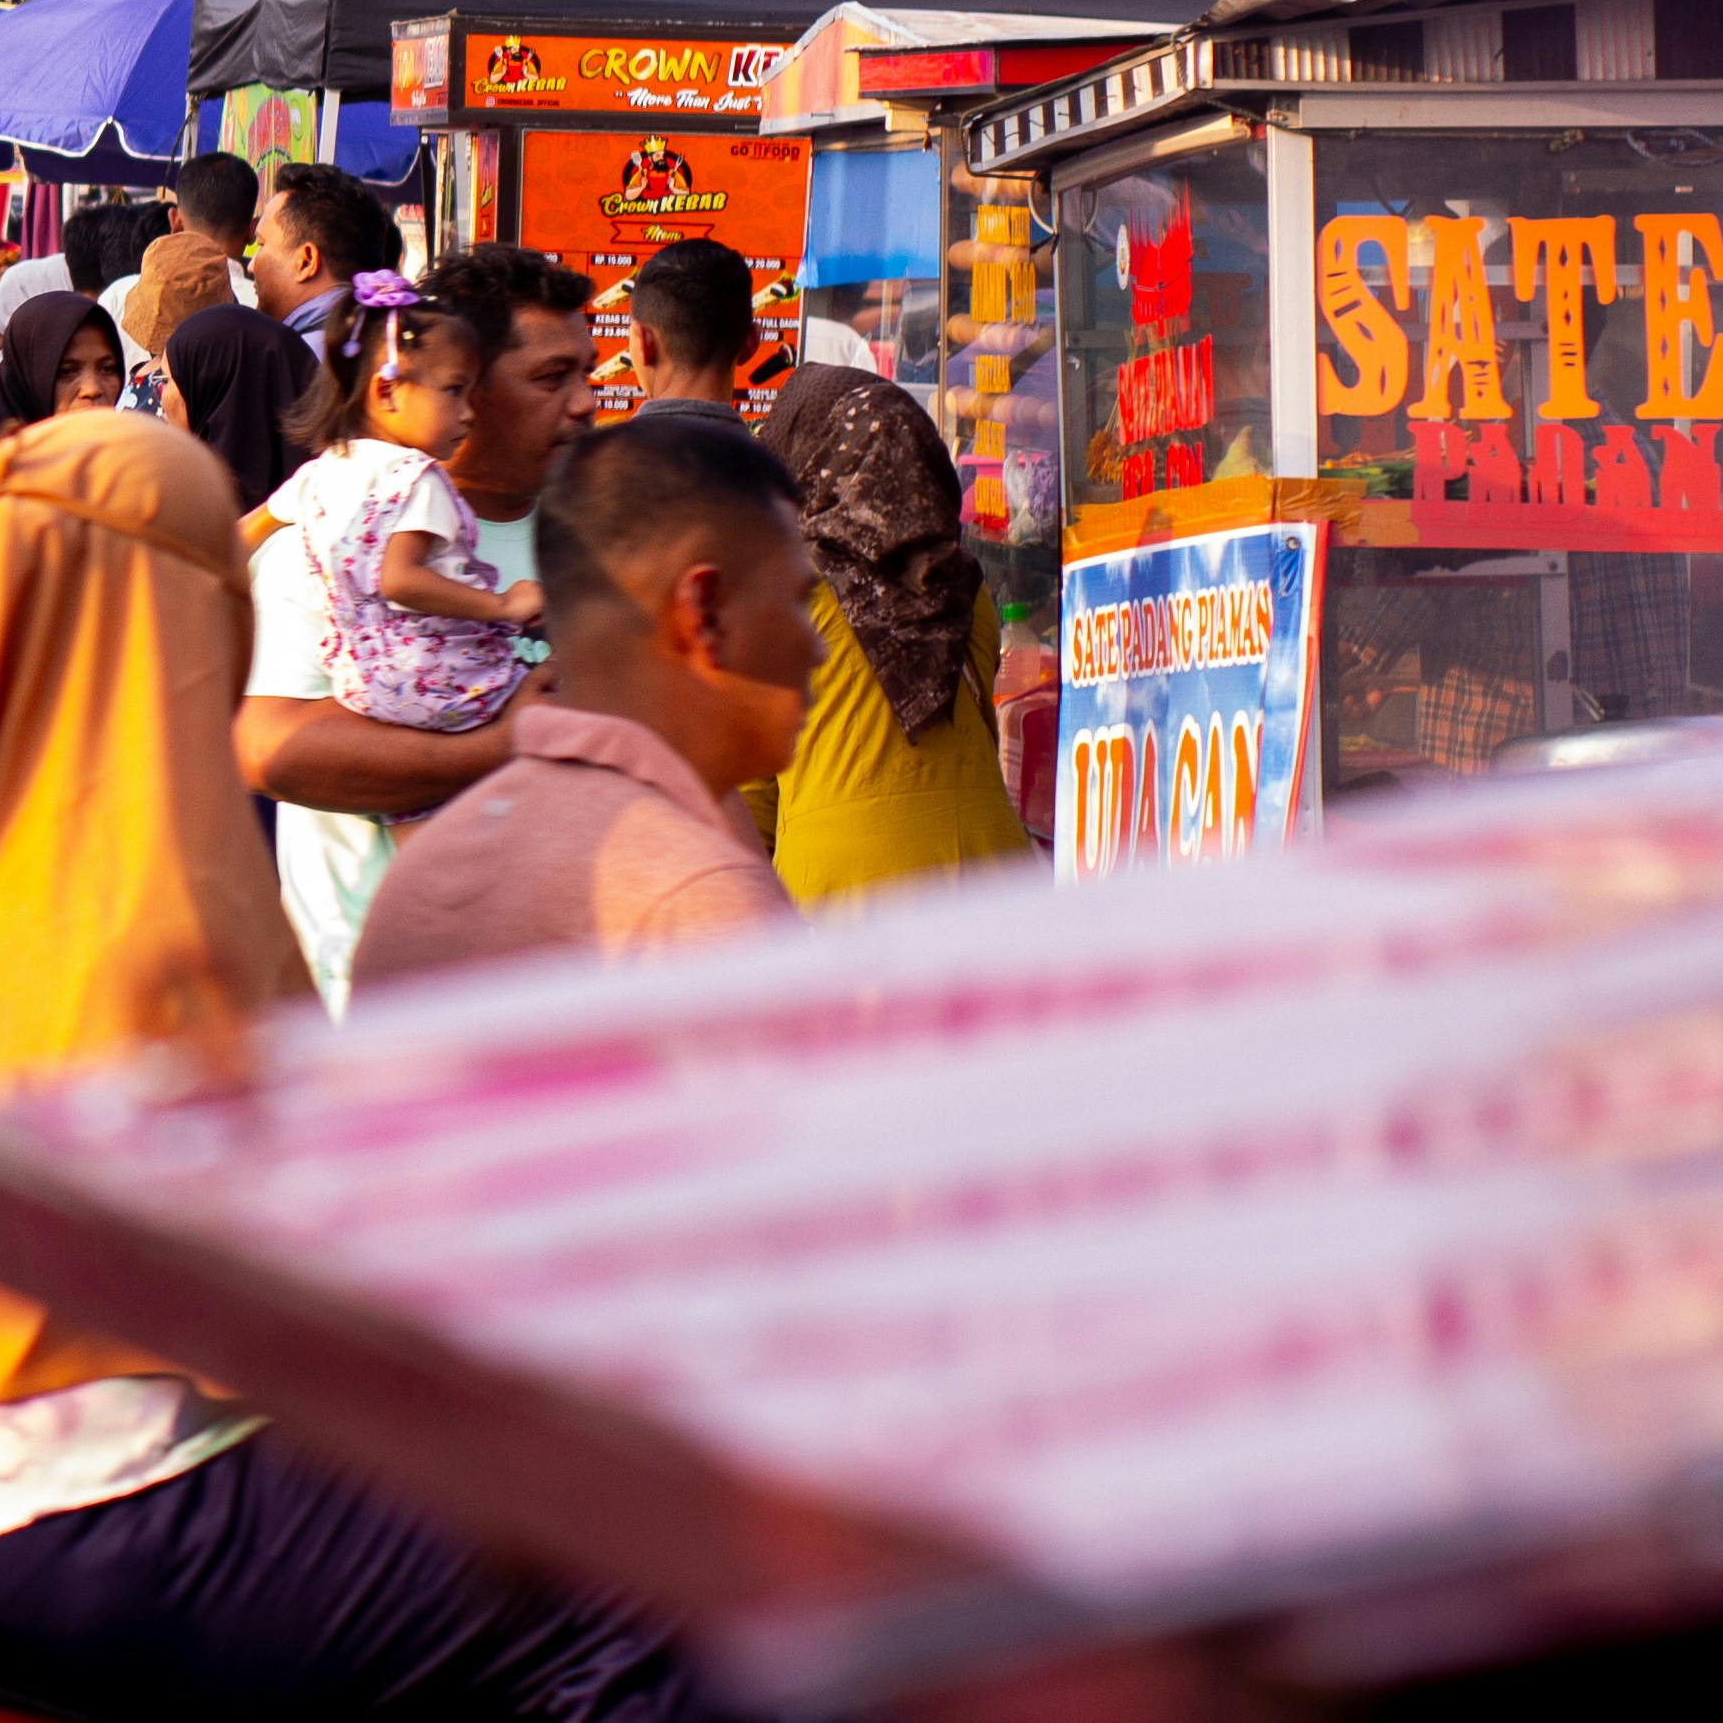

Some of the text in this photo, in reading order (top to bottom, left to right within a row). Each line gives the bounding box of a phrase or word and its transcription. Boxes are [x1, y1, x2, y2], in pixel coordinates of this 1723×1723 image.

[517, 76, 567, 92] KEBAB
[578, 46, 722, 85] CROWN
[600, 192, 728, 218] Crown KEBAB
[1316, 213, 1723, 420] SATE
[1072, 580, 1275, 690] SATE PADANG PIAMAN
[1072, 718, 1160, 884] UDA
